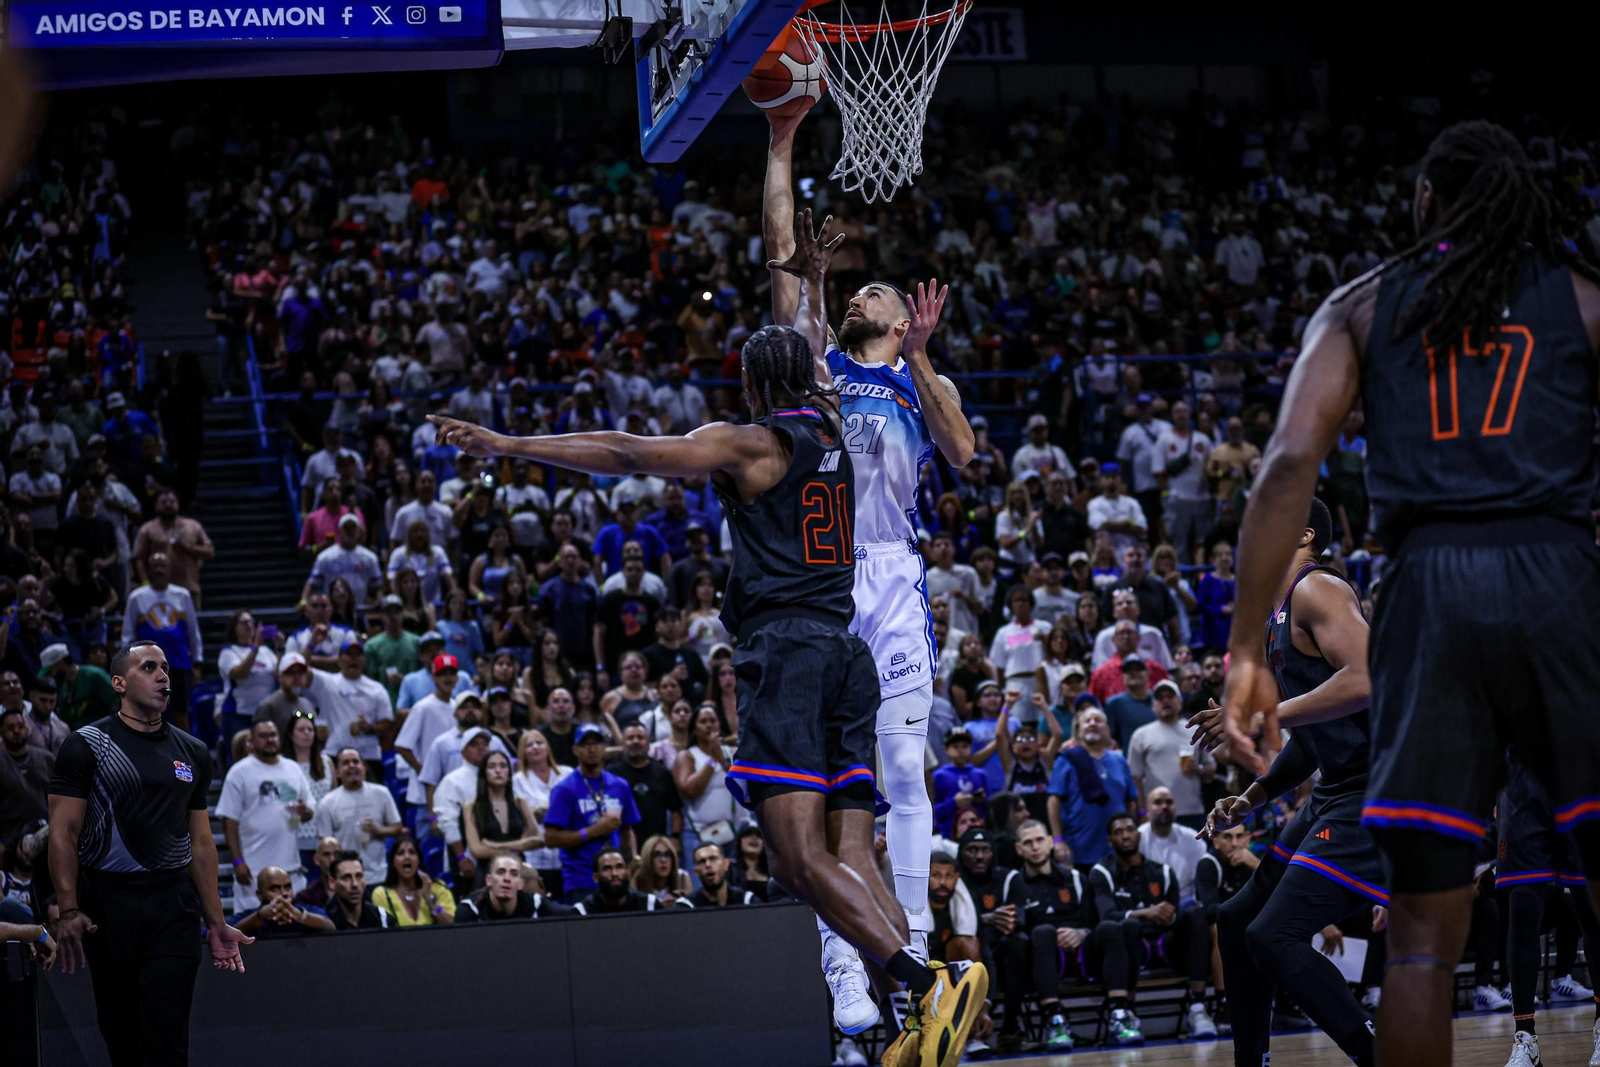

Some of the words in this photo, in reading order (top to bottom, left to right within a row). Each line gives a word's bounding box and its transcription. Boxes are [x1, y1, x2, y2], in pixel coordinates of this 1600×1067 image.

[35, 11, 143, 35] AMIGOS
[149, 9, 183, 30] DE
[188, 6, 325, 29] BAYAMON
[1422, 324, 1536, 441] 17
[843, 412, 888, 455] 27
[802, 481, 852, 565] 21
[881, 662, 922, 682] Liberty
